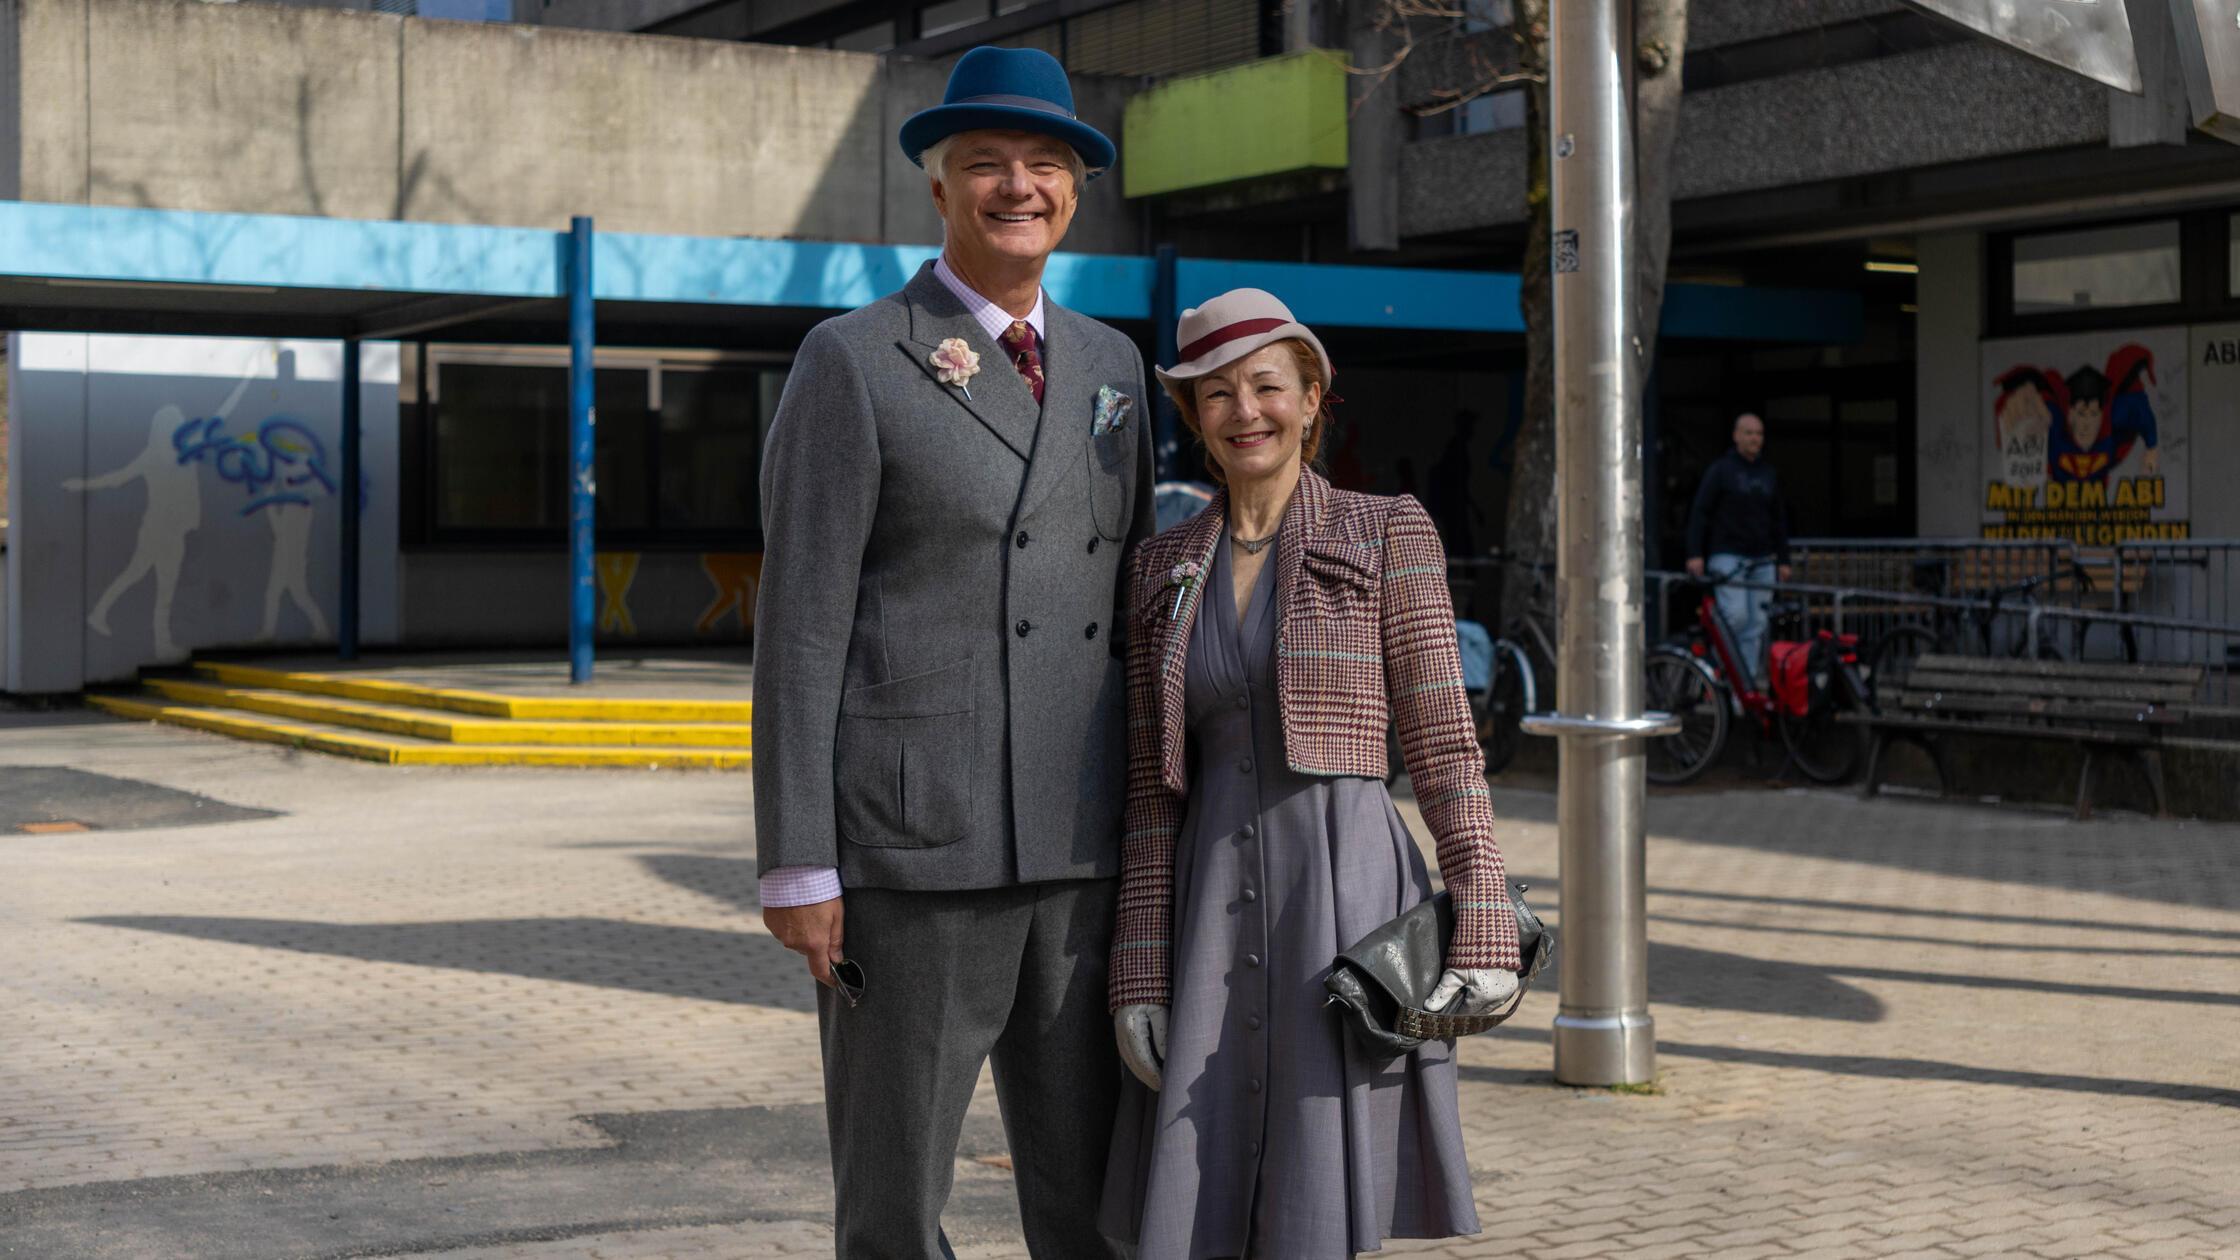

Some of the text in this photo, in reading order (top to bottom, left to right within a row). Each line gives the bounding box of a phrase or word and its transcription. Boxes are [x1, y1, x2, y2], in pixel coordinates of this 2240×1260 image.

[1987, 477, 2165, 509] MIT DEM ABI
[2075, 523, 2188, 545] LEGENDEN
